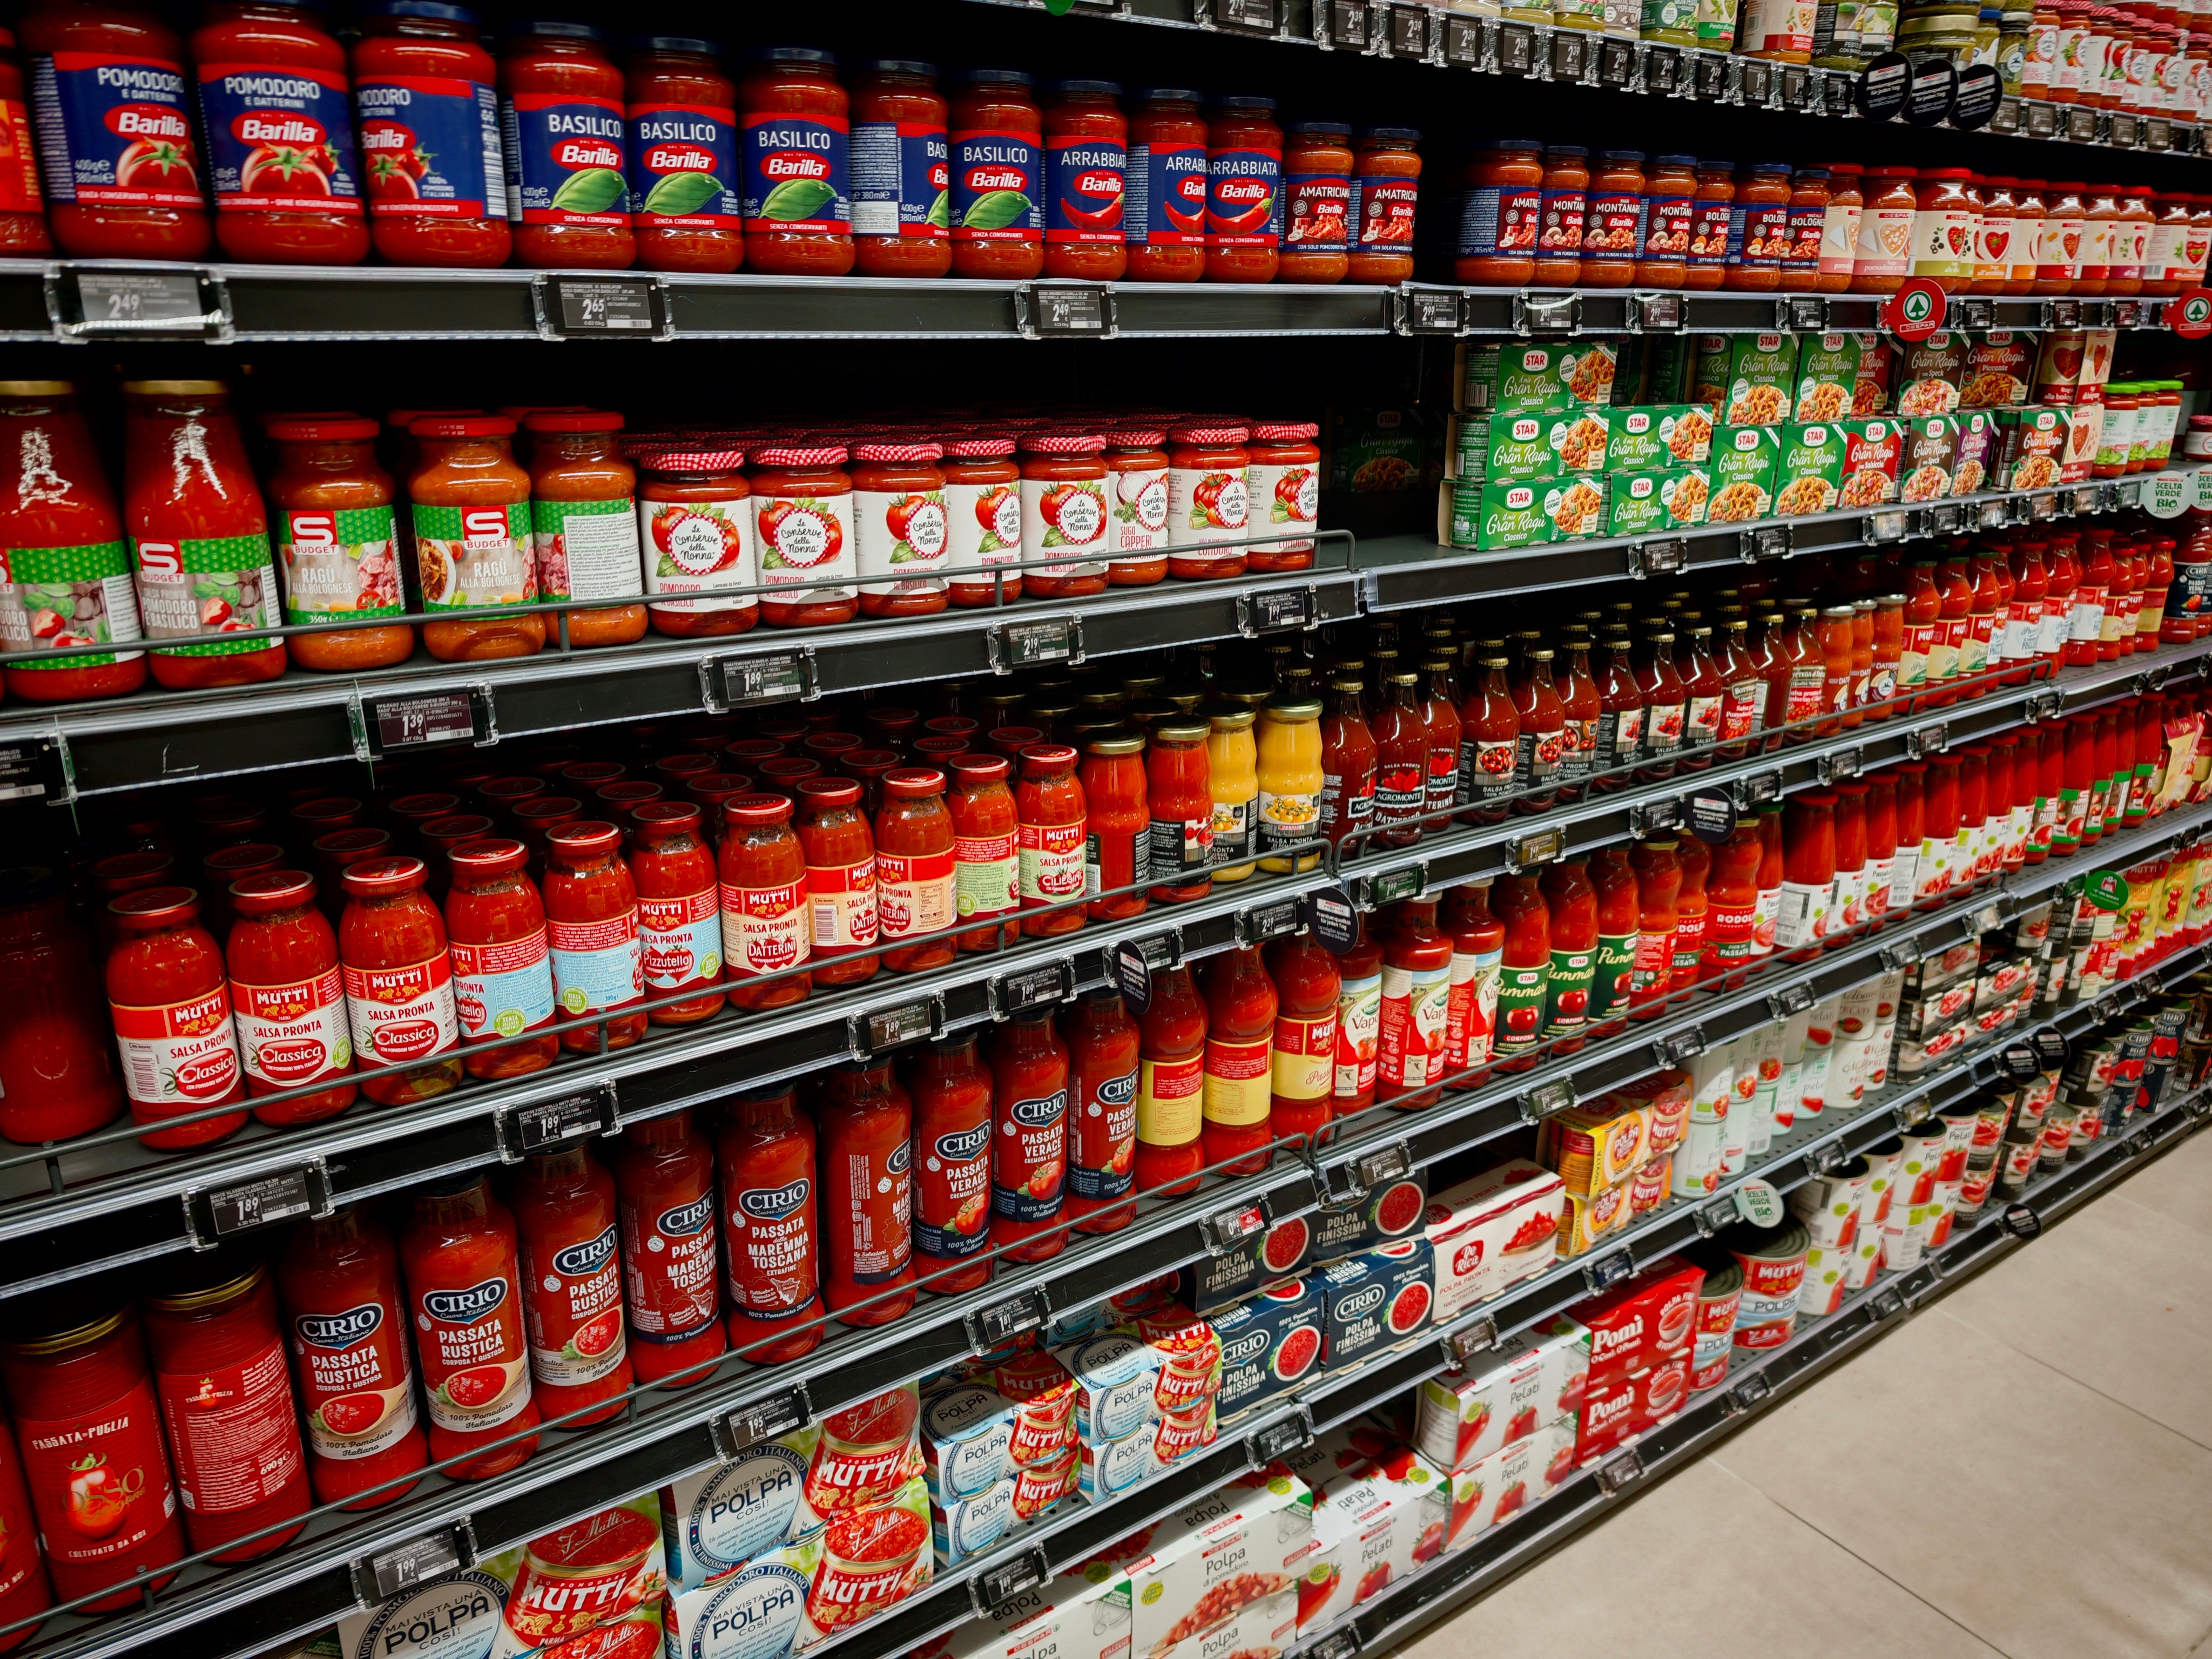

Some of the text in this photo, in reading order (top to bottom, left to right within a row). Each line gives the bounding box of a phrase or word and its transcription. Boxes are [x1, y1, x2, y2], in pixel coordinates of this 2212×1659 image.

[97, 68, 184, 93] POMODORO
[225, 77, 321, 99] POMODORO
[122, 89, 177, 103] E DATTERINI
[118, 112, 186, 137] Barilla
[242, 119, 318, 142] Barilla
[549, 114, 622, 138] BASILICO
[641, 123, 716, 142] BASILICO
[561, 145, 619, 166] Barilla
[651, 151, 710, 169] Barilla
[963, 147, 1027, 163] BASILICO
[1206, 161, 1277, 176] ARRABBIATA
[972, 172, 1021, 188] Barilla
[1222, 184, 1265, 198] Barilla
[1317, 204, 1343, 214] Barilla
[1609, 218, 1634, 226] Barilla
[1760, 336, 1778, 348] STAR
[1989, 332, 2010, 342] STAR
[1526, 355, 1545, 366] STAR
[1968, 346, 2025, 365] Gran Ragù
[1739, 355, 1791, 375] Gran Ragù
[1504, 375, 1561, 397] Gran Ragù
[1754, 374, 1776, 382] Classico
[1520, 396, 1543, 406] Classico
[1869, 425, 1883, 437] STAR
[2156, 482, 2182, 490] SCELTA
[692, 524, 700, 533] Le
[1121, 527, 1136, 535] SUGO
[295, 546, 338, 554] BUDGET
[689, 544, 706, 552] della
[1121, 535, 1152, 548] CAPPERI
[302, 566, 335, 583] RAGÙ
[293, 581, 352, 594] ALLA BOLOGNESE
[1377, 793, 1421, 801] AGROMONTE
[1047, 829, 1078, 840] MUTTI
[1040, 853, 1082, 867] SALSA PRONTA
[750, 891, 790, 905] MUTTI
[743, 919, 798, 933] SALSA PRONTA
[748, 939, 797, 956] DATTERINI
[1720, 947, 1749, 956] PASSATA
[644, 953, 690, 968] Pizzutello
[1520, 974, 1535, 982] STAR
[257, 988, 308, 1004] MUTTI
[254, 1020, 322, 1037] SALSA PRONTA
[259, 1046, 321, 1064] Classica
[1018, 1096, 1065, 1120] CIRIO
[1022, 1124, 1063, 1145] PASSATA
[1615, 1128, 1639, 1145] POLPA
[1652, 1122, 1676, 1136] MUTTI
[1025, 1137, 1062, 1157] VERACE
[747, 1185, 805, 1209] CIRIO
[752, 1216, 804, 1238] PASSATA
[1327, 1212, 1358, 1228] POLPA
[1317, 1221, 1367, 1245] FINISSIMA
[748, 1232, 809, 1256] MAREMMA
[1464, 1246, 1476, 1260] De
[752, 1247, 807, 1269] TOSCANA
[1455, 1255, 1479, 1272] Rica
[767, 1264, 797, 1276] EXTRAFINE
[1758, 1262, 1803, 1278] MUTTI
[1440, 1267, 1490, 1293] POLPA PRONTA
[1339, 1290, 1381, 1313] CIRIO
[302, 1311, 375, 1336] CIRIO
[1345, 1317, 1374, 1335] POLPA
[1336, 1325, 1381, 1352] FINISSIMA
[312, 1345, 378, 1368] PASSATA
[442, 1357, 471, 1365] CORPOSA
[478, 1347, 505, 1362] GUSTOSA
[315, 1362, 380, 1384] RUSTICA
[1115, 1382, 1152, 1406] POLPA
[1161, 1377, 1204, 1394] MUTTI
[1511, 1382, 1539, 1401] Pelati
[88, 1417, 129, 1437] PUGLIA
[32, 1432, 83, 1450] PASSATA
[326, 1429, 393, 1449] 100% Pomodoro
[1016, 1427, 1064, 1446] MUTTI
[342, 1445, 379, 1457] Italiano
[965, 1437, 1007, 1462] POLPA
[818, 1454, 899, 1486] MUTTI
[712, 1464, 788, 1504] MAI VISTA UNA
[711, 1470, 793, 1523] POLPA
[736, 1500, 770, 1519] COSÌ!
[1362, 1538, 1393, 1562] Pelati
[1204, 1547, 1245, 1575] Polpa
[522, 1580, 625, 1609] MUTTI
[383, 1598, 490, 1654] POLPA
